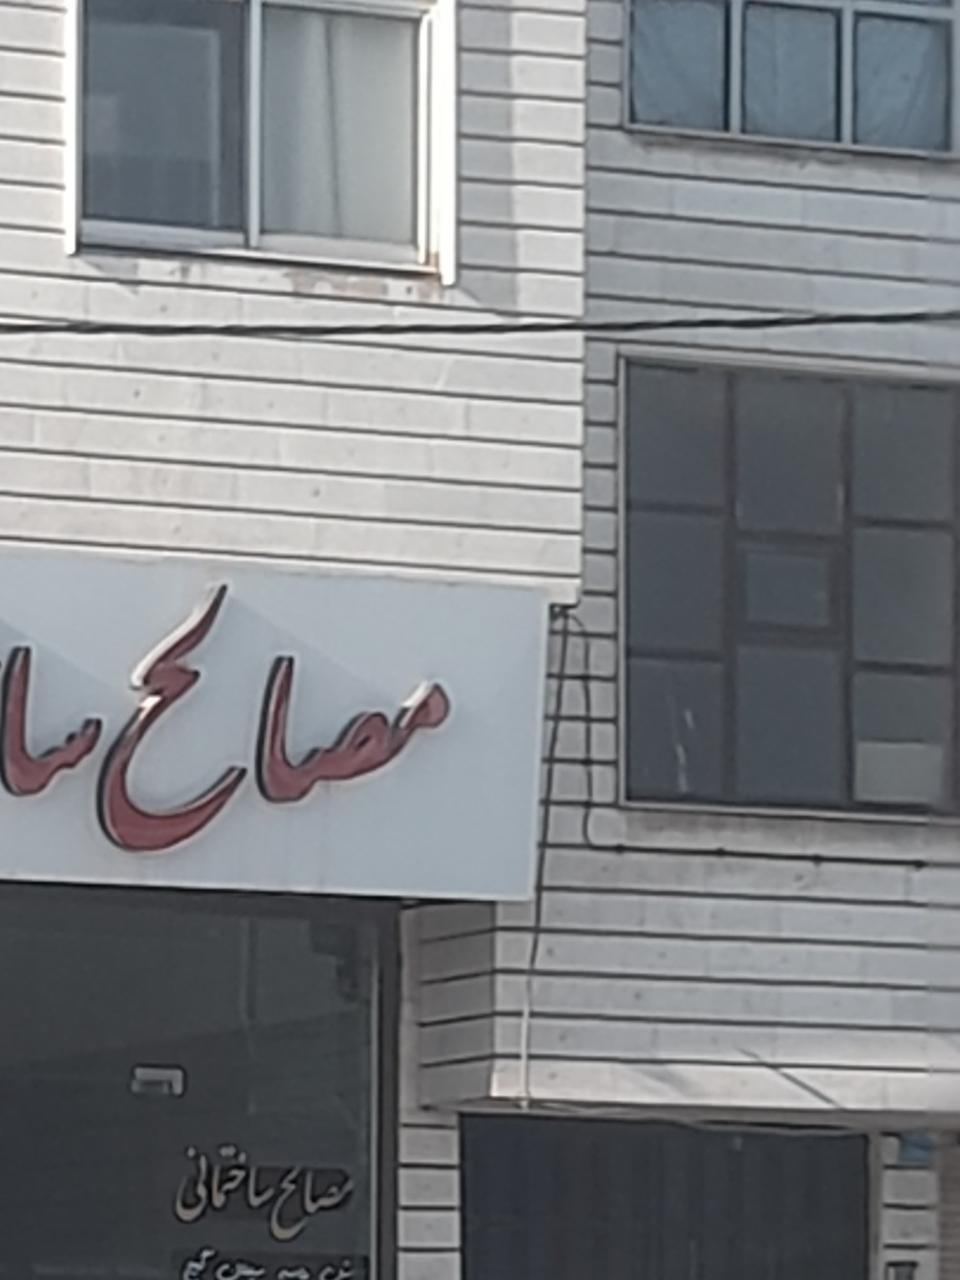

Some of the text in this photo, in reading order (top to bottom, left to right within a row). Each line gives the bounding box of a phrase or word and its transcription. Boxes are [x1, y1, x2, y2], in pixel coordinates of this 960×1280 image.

[94, 584, 451, 853] مصالح
[176, 1145, 354, 1240] مصالح ساختمانی
